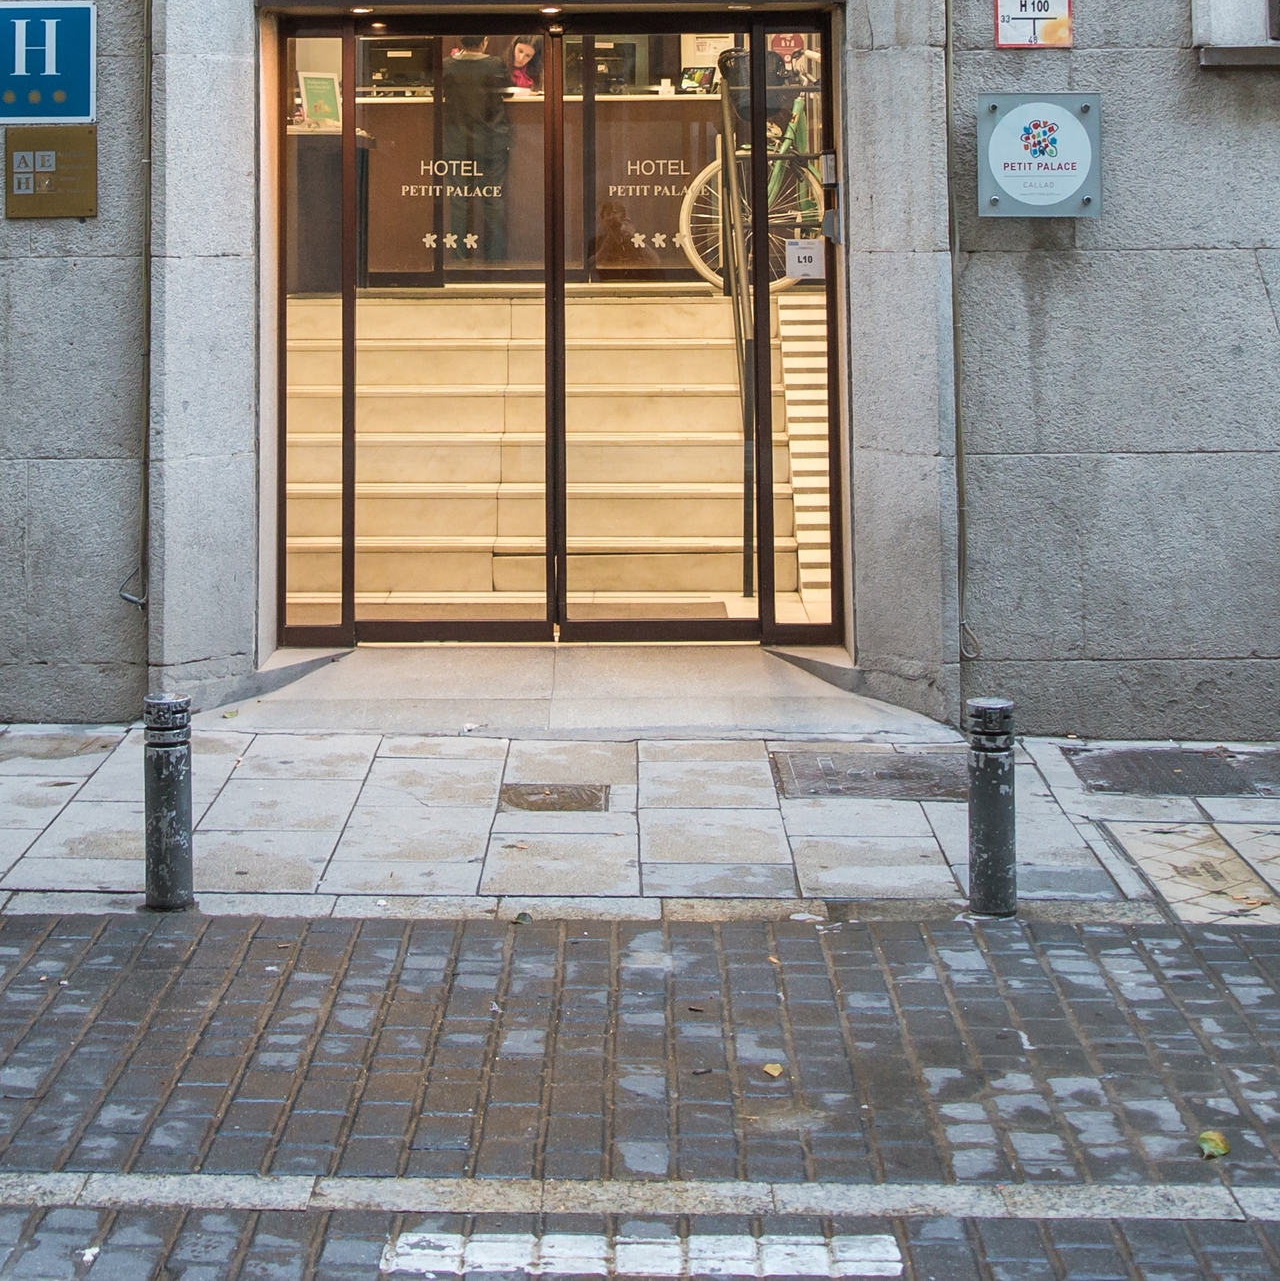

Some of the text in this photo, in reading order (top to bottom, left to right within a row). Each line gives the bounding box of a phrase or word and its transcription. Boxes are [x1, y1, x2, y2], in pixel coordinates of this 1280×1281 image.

[1020, 0, 1049, 12] H 100
[1001, 14, 1011, 23] 33
[10, 19, 62, 76] H
[420, 160, 484, 176] HOTEL
[627, 160, 691, 176] HOTEL
[1003, 162, 1077, 171] PETIT PALACE
[401, 185, 502, 197] PETIT PALACE
[608, 185, 651, 197] PETIT
[1023, 181, 1055, 189] CALLAO
[797, 255, 813, 264] L10
